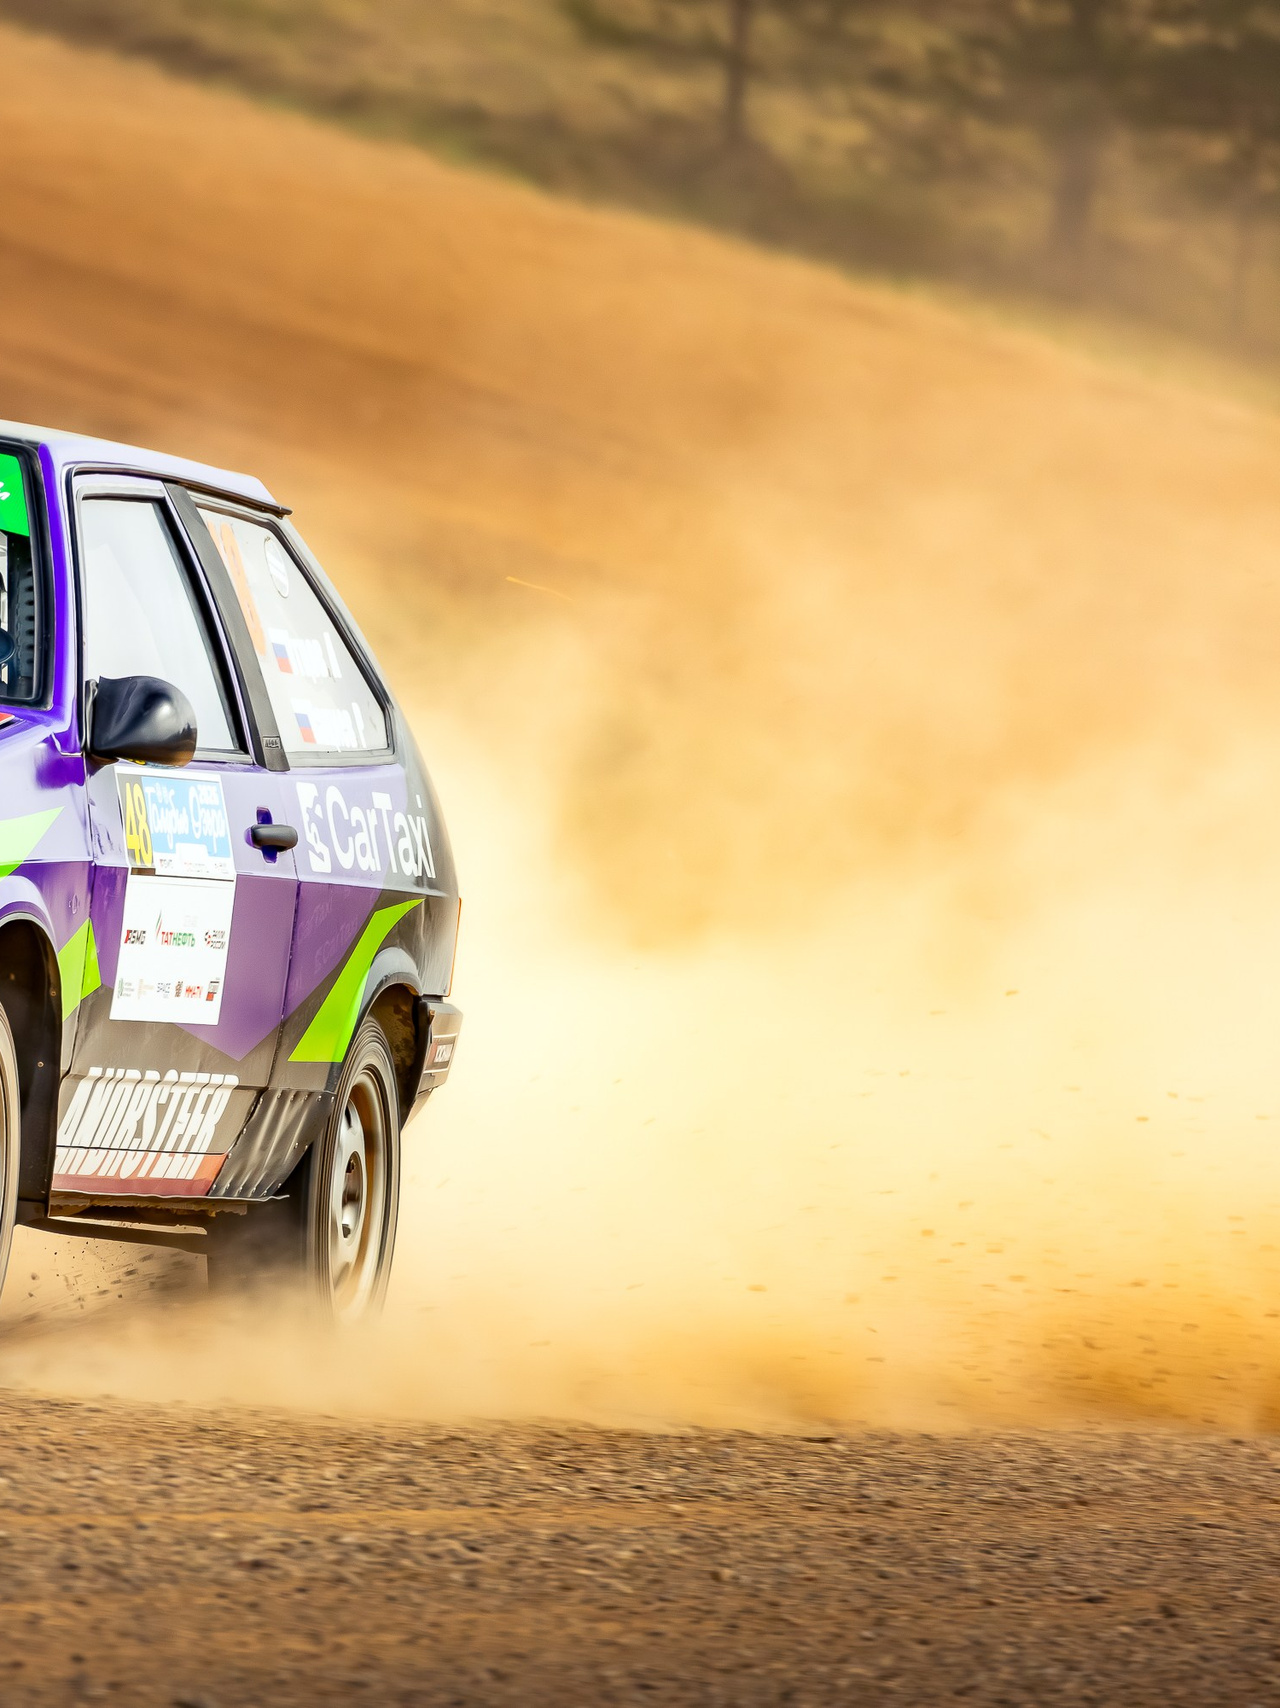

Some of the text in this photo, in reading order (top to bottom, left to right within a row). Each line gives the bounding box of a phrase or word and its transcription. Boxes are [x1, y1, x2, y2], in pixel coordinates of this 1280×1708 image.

[125, 782, 153, 867] 48
[326, 785, 436, 879] CarTaxi
[161, 931, 196, 947] ТАТНЕФТЬ
